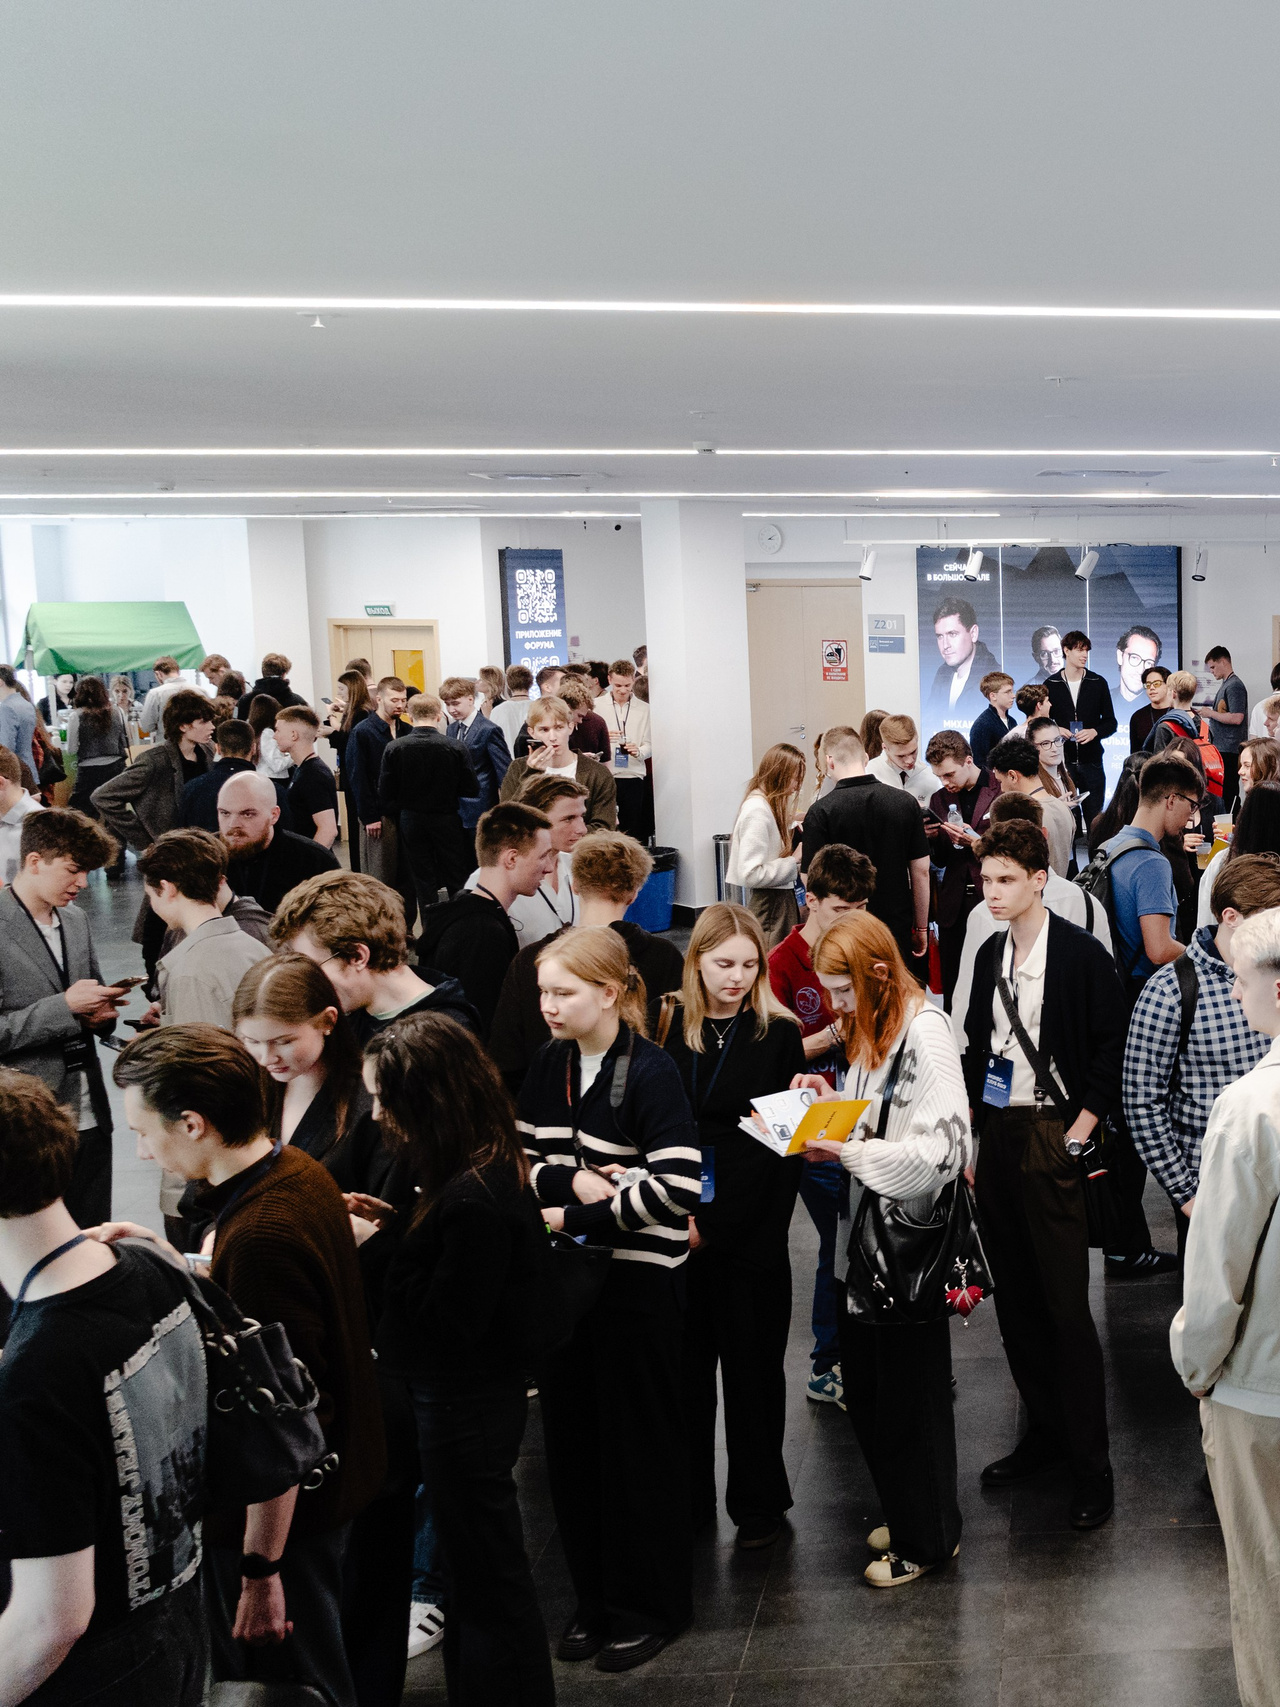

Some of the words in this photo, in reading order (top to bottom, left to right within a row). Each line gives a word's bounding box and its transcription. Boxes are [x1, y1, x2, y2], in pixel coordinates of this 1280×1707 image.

[943, 563, 967, 571] СЕЙЧА
[874, 620, 897, 630] Z201
[515, 629, 562, 639] ПРИЛОЖЕНИЕ
[524, 641, 555, 650] ФОРУМА
[106, 1390, 141, 1488] JEANS
[121, 1493, 150, 1599] TOMMY
